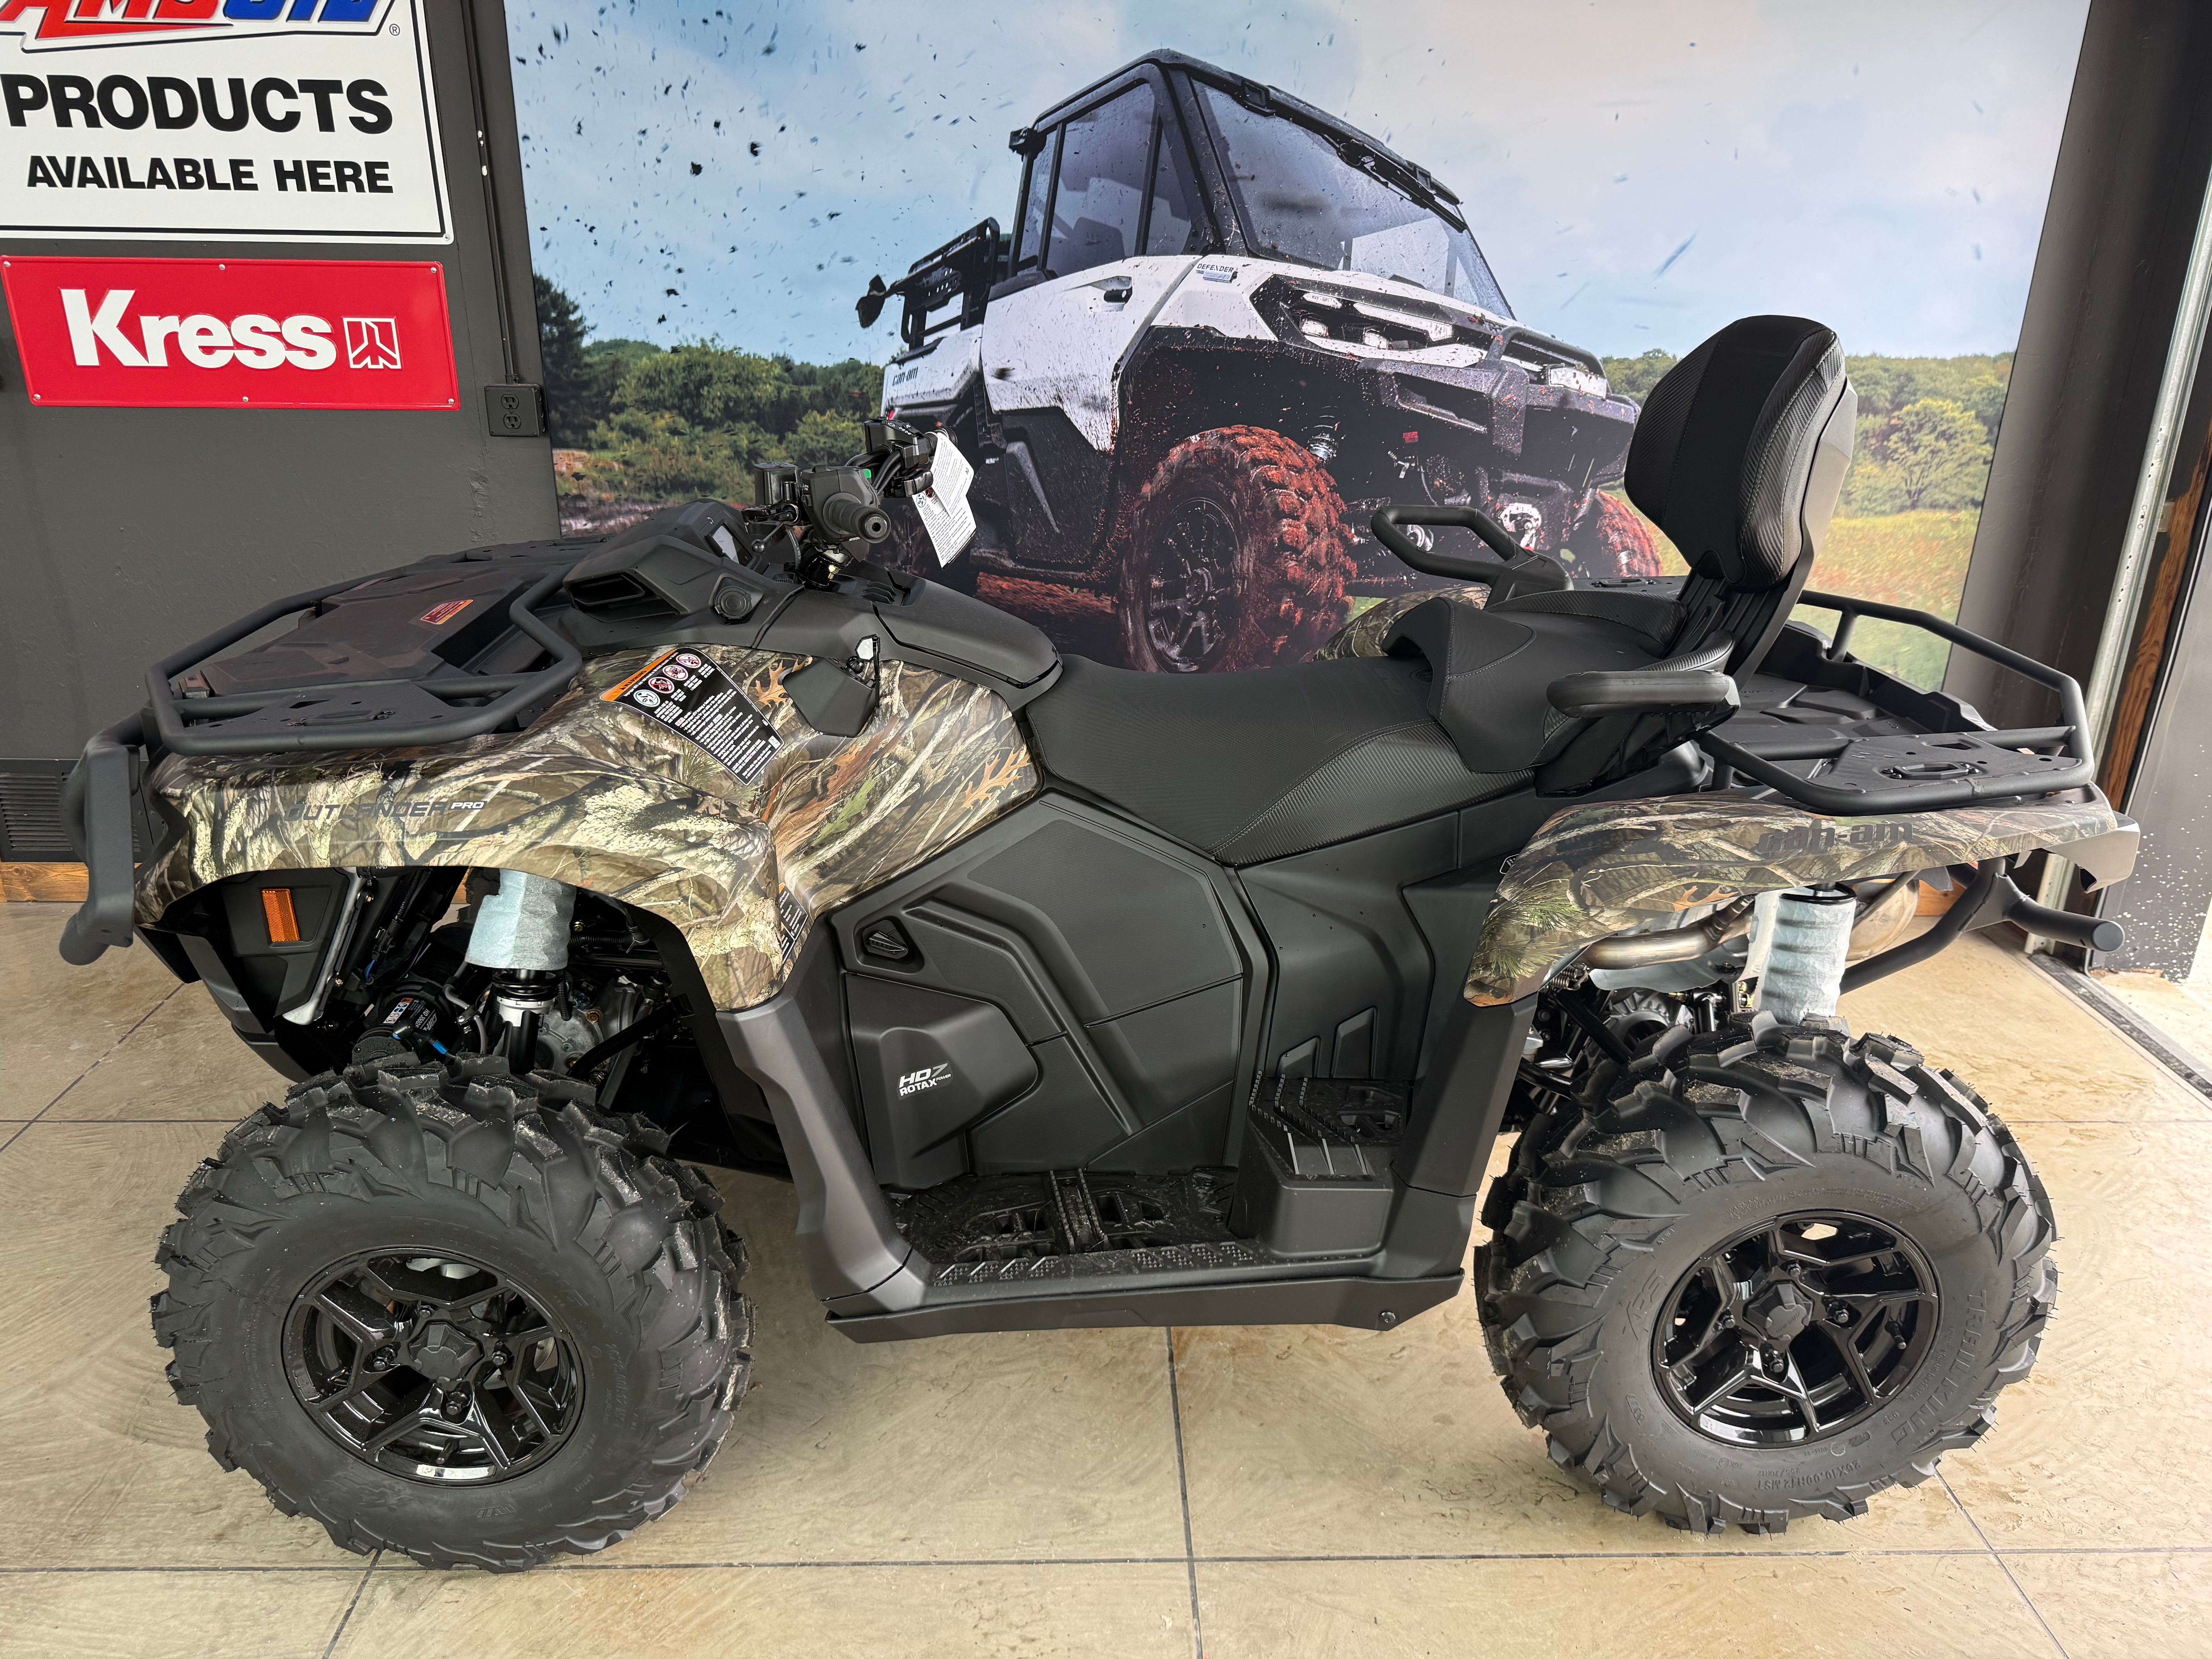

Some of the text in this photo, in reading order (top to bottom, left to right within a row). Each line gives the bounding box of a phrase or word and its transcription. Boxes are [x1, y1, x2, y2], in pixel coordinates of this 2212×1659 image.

[1, 74, 393, 134] PRODUCTS
[27, 155, 394, 194] AVAILABLE HERE
[1197, 263, 1234, 273] DEFENDER
[59, 288, 337, 370] Kress
[892, 366, 918, 386] can-am
[284, 801, 485, 821] OUTLANDER PRO
[1757, 821, 1913, 853] can-am
[423, 1008, 430, 1017] HD
[899, 1063, 948, 1088] HD7
[899, 1079, 937, 1096] ROTAX
[1949, 1290, 1986, 1374] TRAIL
[1891, 1377, 1958, 1445] KING
